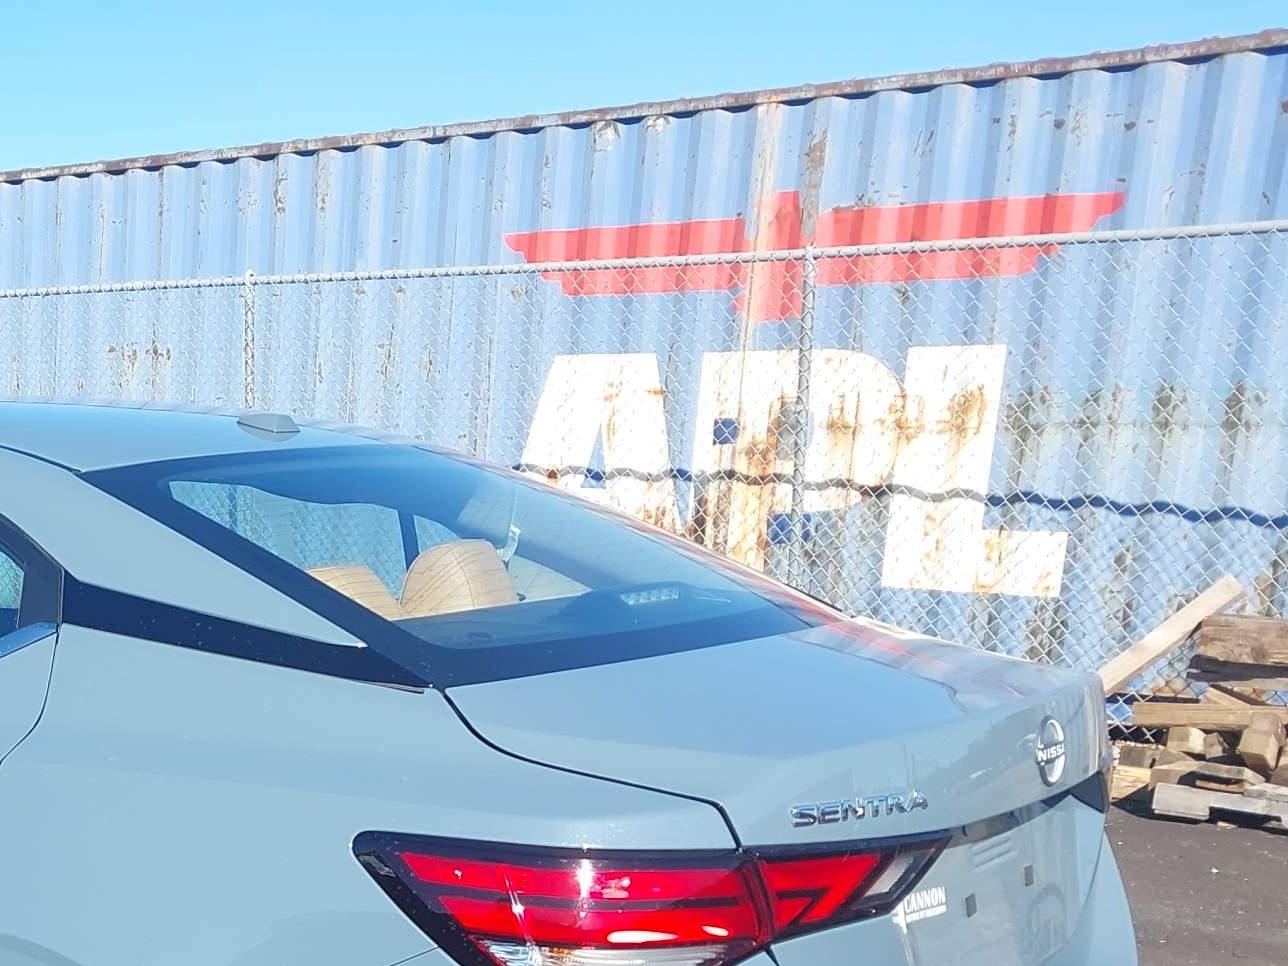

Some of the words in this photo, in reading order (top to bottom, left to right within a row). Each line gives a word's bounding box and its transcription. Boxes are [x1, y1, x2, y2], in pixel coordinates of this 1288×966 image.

[518, 344, 1069, 598] APL
[1036, 743, 1066, 762] NISS
[791, 790, 928, 828] SENTRA
[904, 886, 946, 914] CANNON
